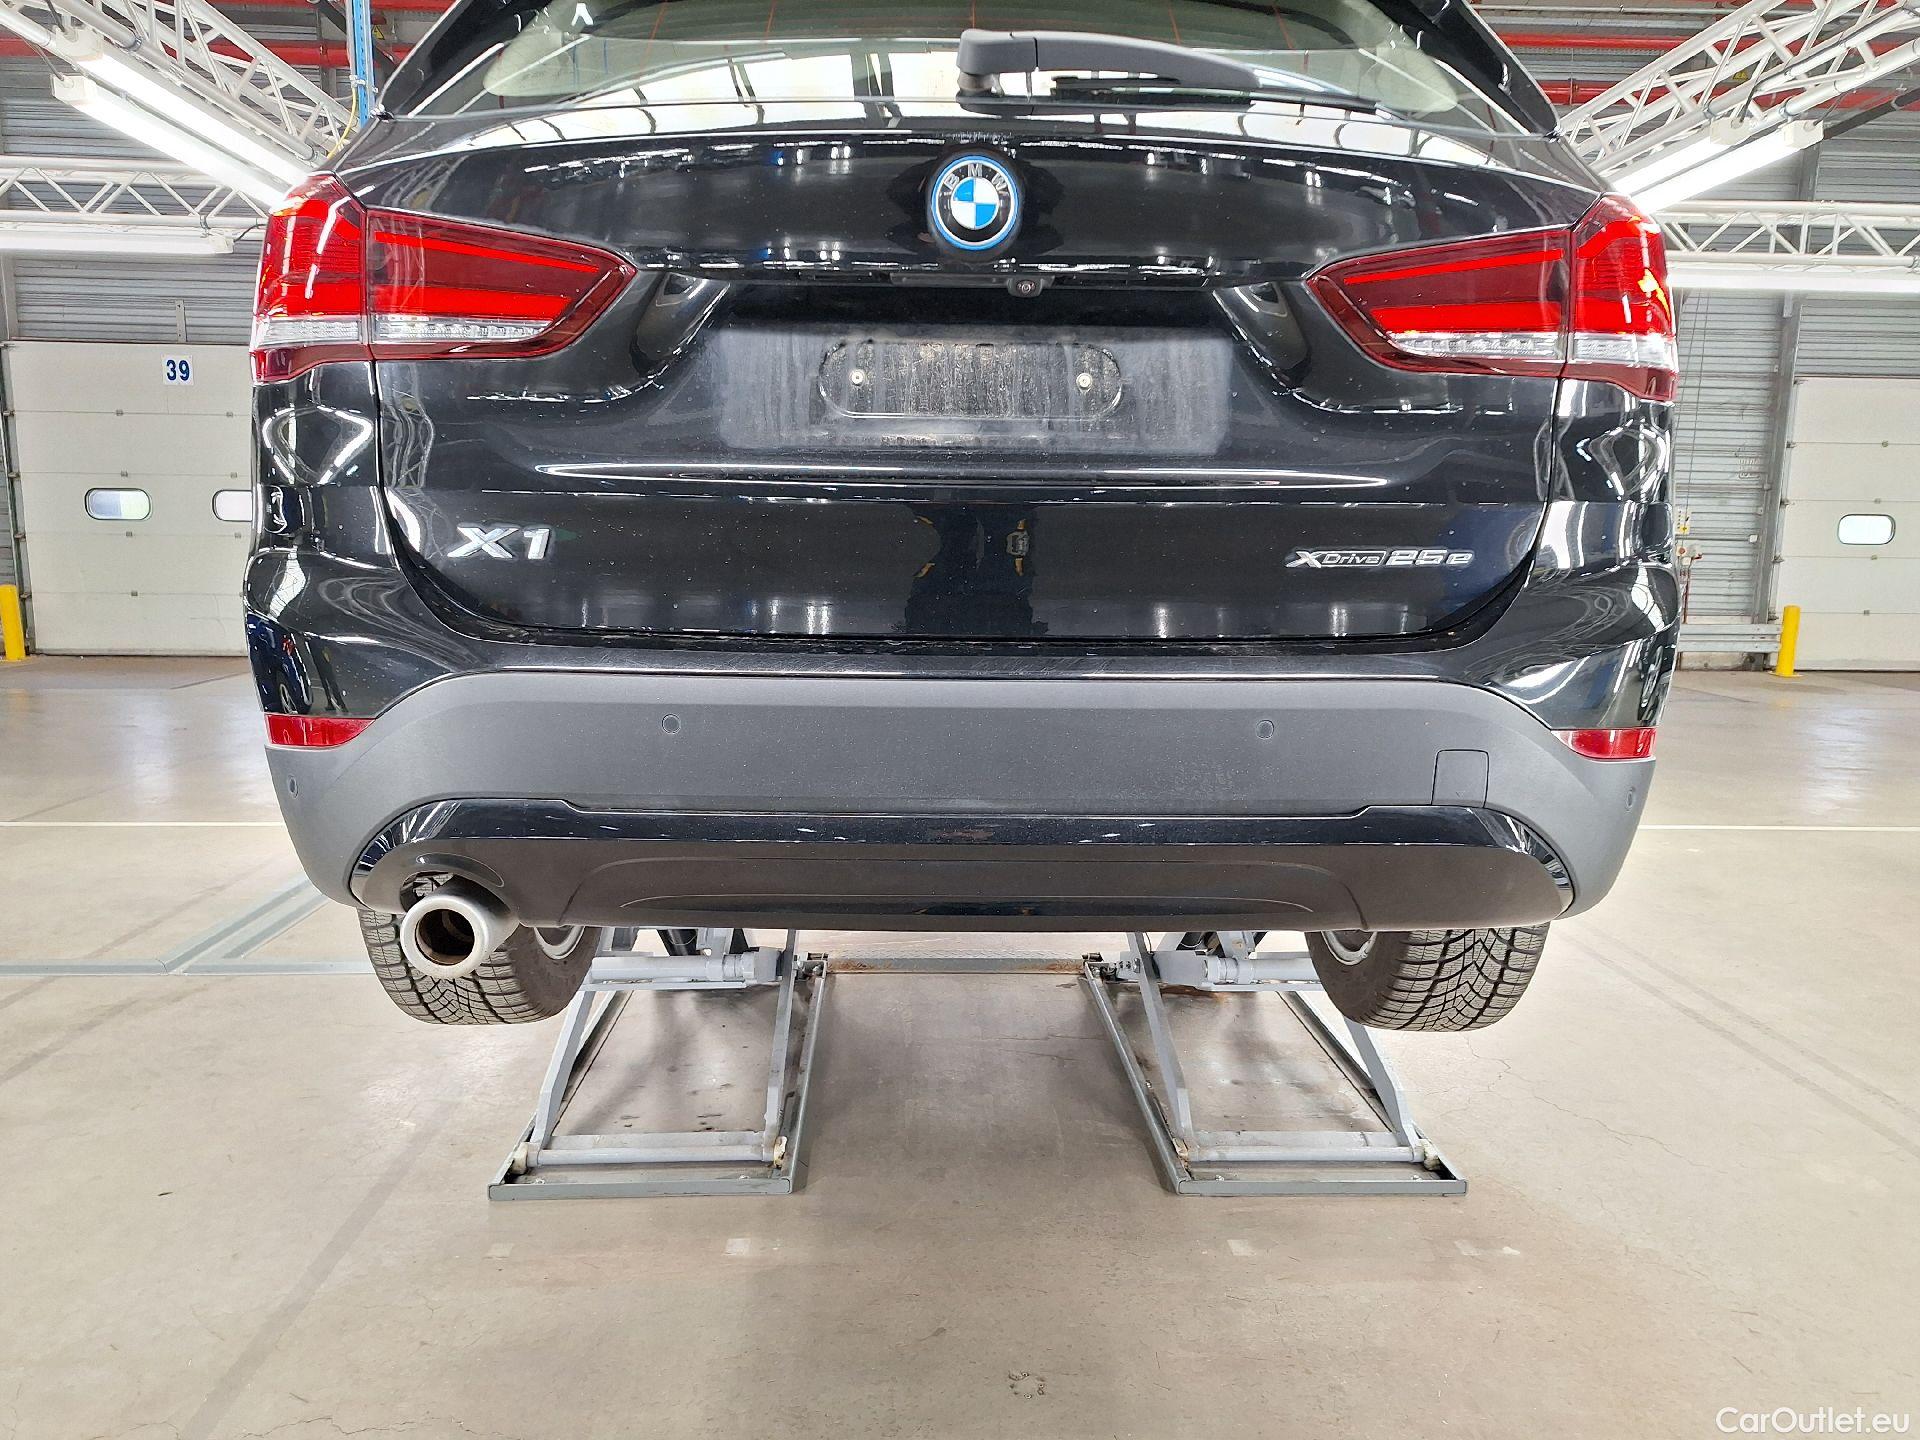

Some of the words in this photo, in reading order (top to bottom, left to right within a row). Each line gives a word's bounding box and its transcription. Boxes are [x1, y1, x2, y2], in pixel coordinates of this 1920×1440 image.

[943, 163, 1009, 194] BMW
[166, 360, 190, 381] 39
[447, 527, 550, 559] X1
